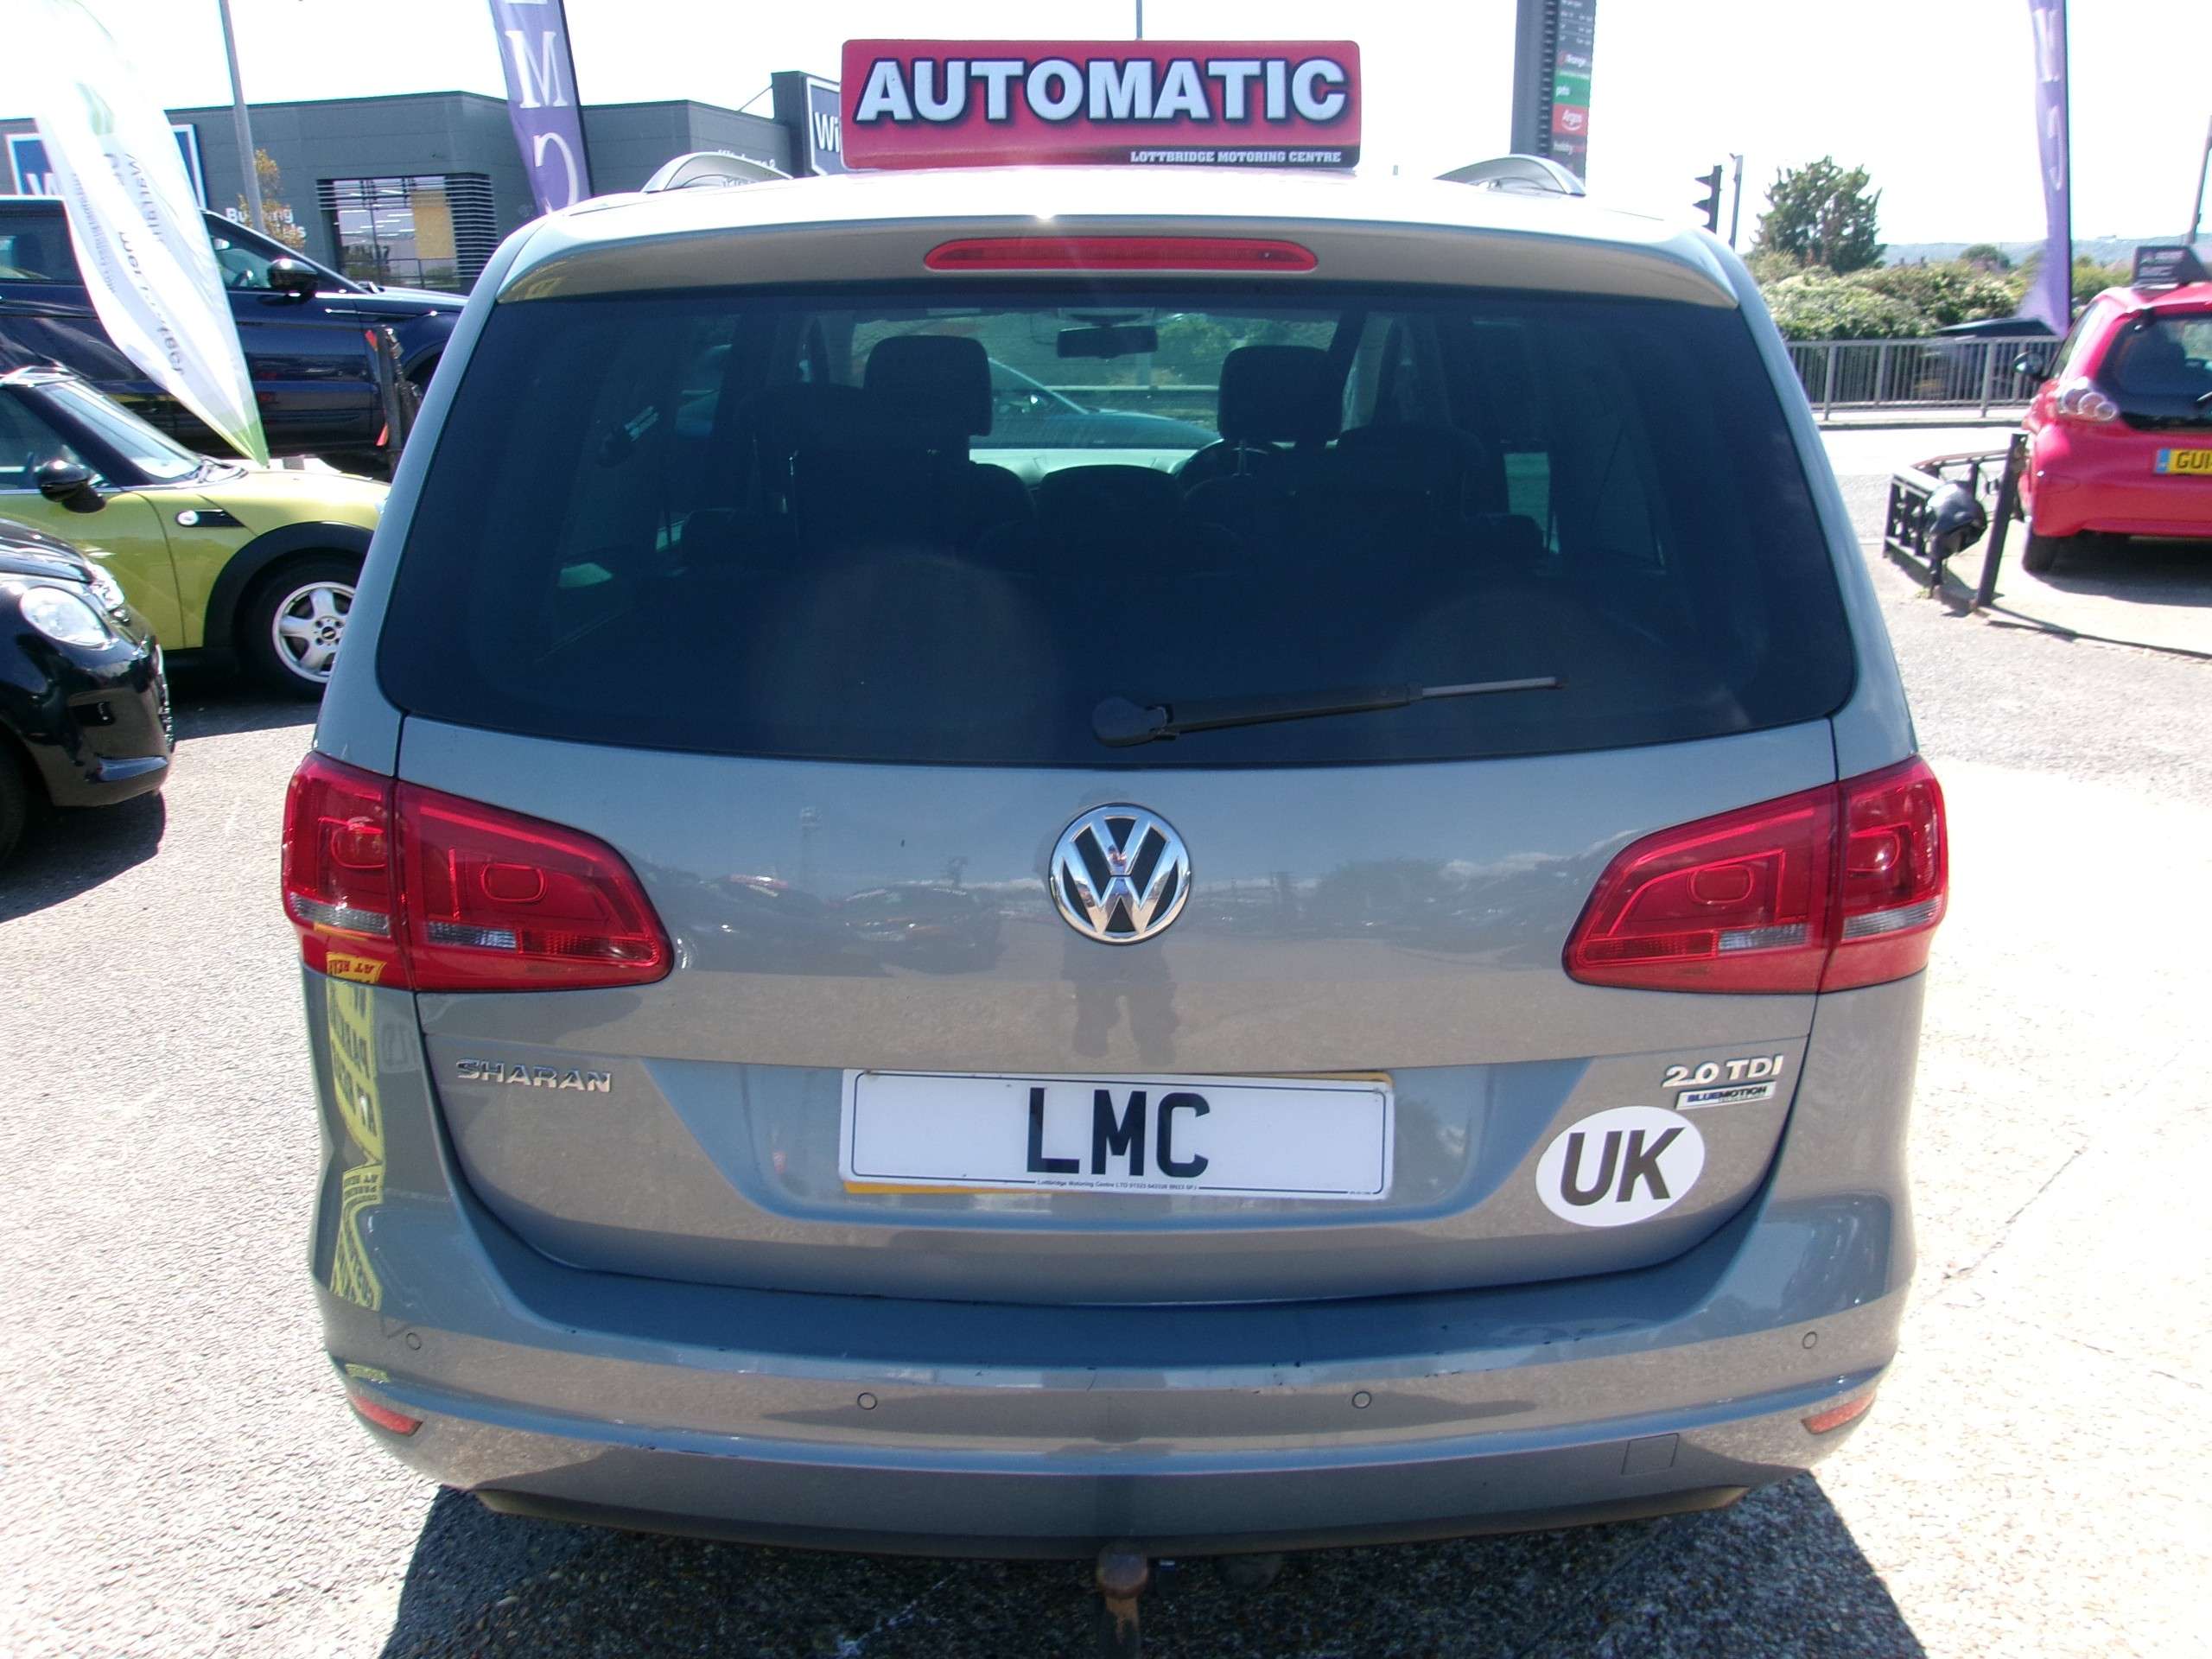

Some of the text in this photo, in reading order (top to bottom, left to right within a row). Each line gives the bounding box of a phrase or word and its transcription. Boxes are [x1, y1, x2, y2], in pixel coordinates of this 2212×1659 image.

[856, 60, 1346, 122] AUTOMATIC
[1129, 150, 1342, 163] LOTTBRIDGE MOTORING CENTRE
[455, 1057, 612, 1093] SHARAN
[1726, 1054, 1784, 1081] TDI
[1687, 1085, 1767, 1103] BLUEMOTION
[1027, 1087, 1211, 1178] LMC
[1560, 1127, 1685, 1206] UK
